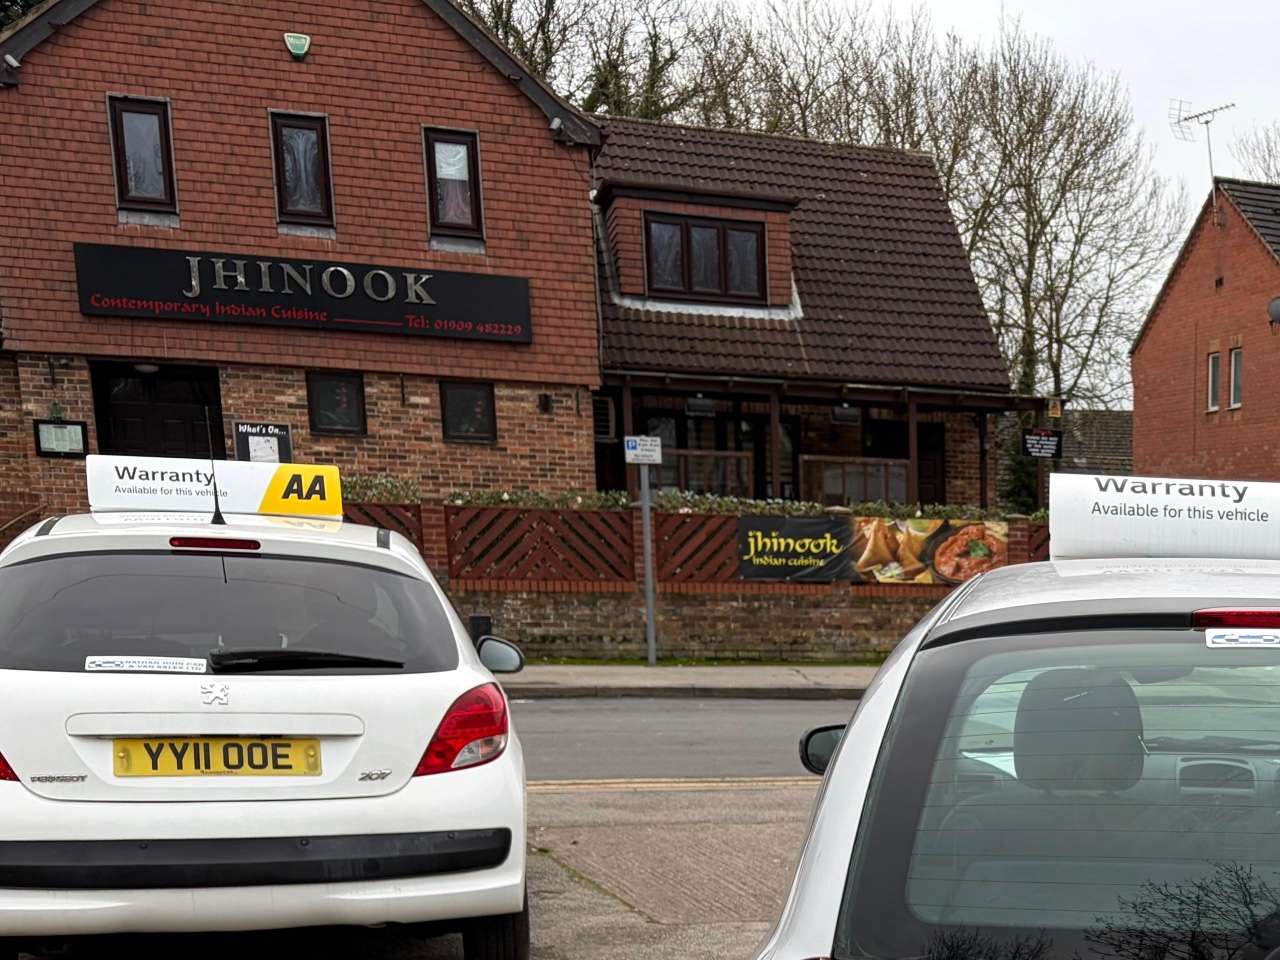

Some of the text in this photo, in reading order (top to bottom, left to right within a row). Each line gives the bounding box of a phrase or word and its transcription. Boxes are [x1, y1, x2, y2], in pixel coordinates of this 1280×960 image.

[182, 256, 436, 305] JHINOOK
[90, 293, 211, 317] Contemporary
[215, 302, 266, 317] Indian
[270, 305, 327, 321] Cuisine
[405, 314, 430, 329] Tel:
[434, 319, 473, 331] 01909
[238, 424, 266, 434] What's
[114, 466, 327, 501] Warranty AA
[114, 485, 157, 495] Available
[160, 486, 173, 496] for
[175, 487, 193, 497] this
[1094, 477, 1249, 503] Warranty
[1091, 501, 1269, 522] Available for this vehicle
[743, 530, 845, 561] jhinook
[143, 741, 293, 770] YY11 OOE
